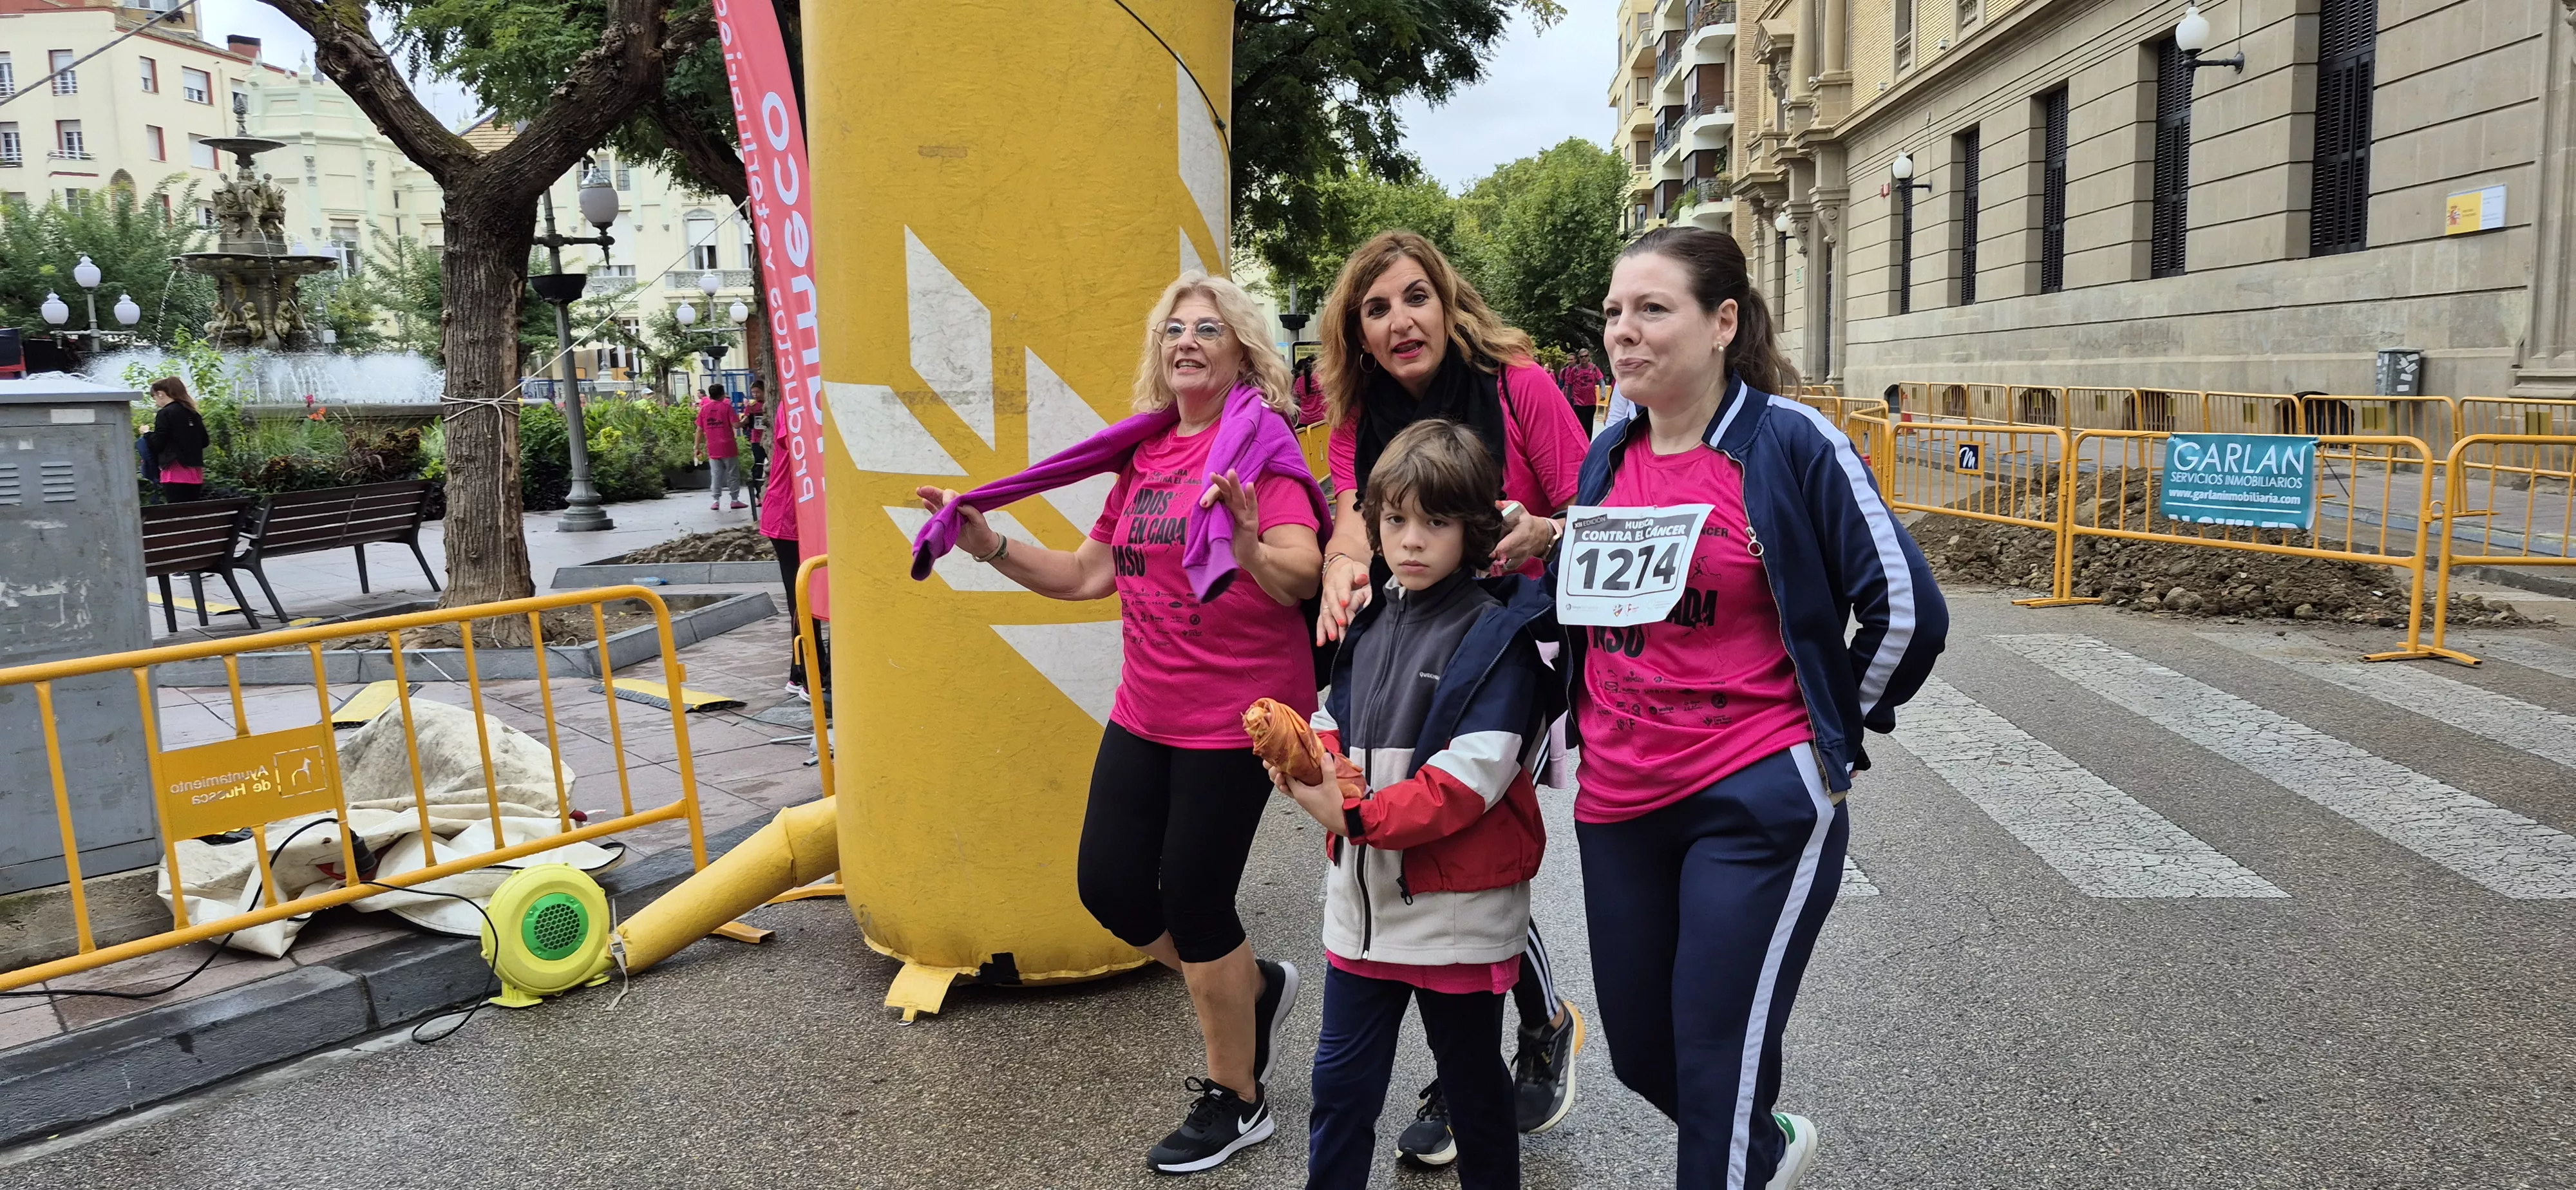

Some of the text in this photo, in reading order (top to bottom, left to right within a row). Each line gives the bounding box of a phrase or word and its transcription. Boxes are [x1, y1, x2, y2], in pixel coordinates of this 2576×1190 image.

[2174, 442, 2307, 475] GARLAN
[2170, 471, 2303, 489] SERVICIOS INMOBILIARIOS
[1583, 515, 1606, 527] EDICIÓN
[1625, 518, 1654, 529] HUESCA
[1582, 524, 1687, 541] CONTRA EL CÁNCER
[1576, 542, 1681, 591] 1274
